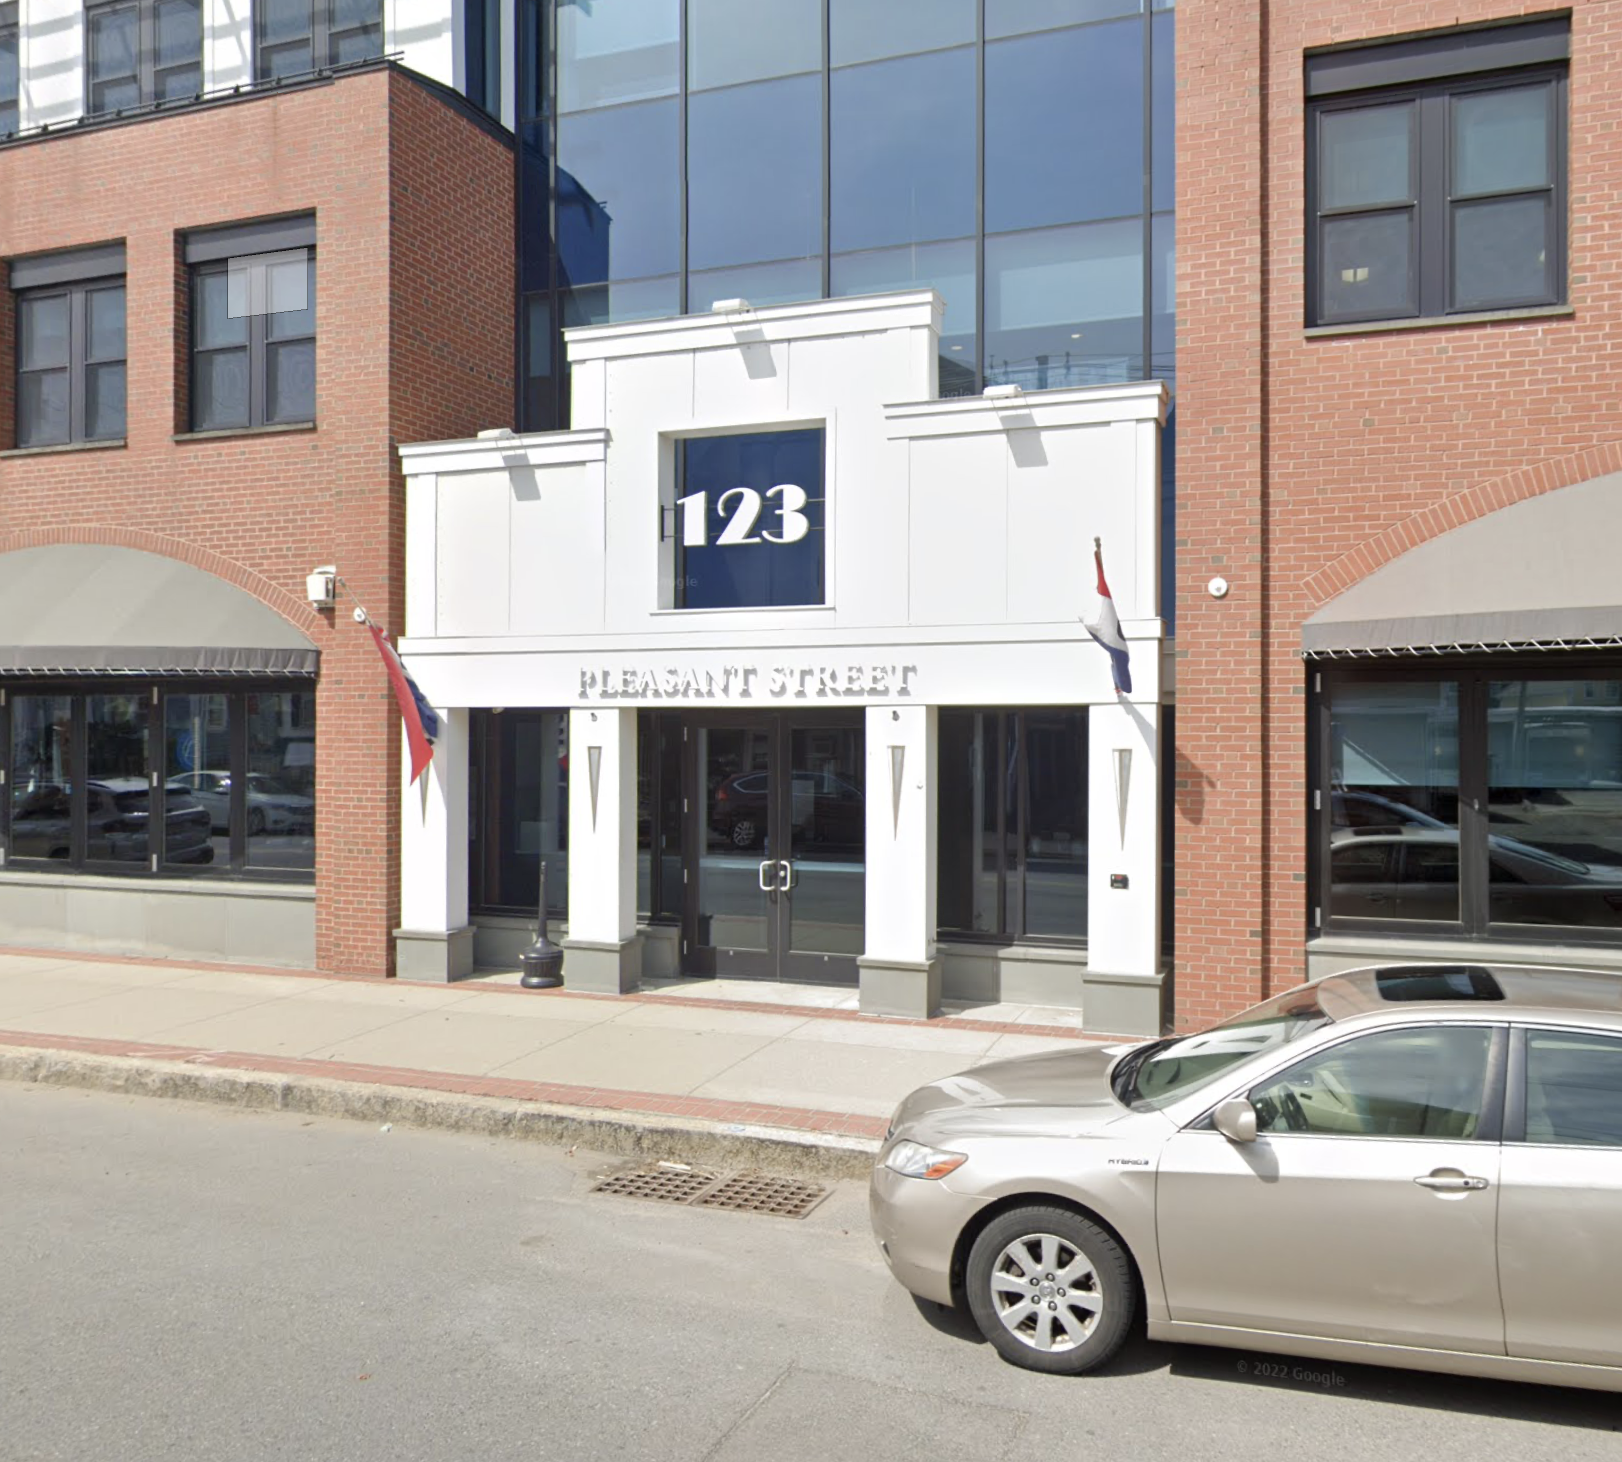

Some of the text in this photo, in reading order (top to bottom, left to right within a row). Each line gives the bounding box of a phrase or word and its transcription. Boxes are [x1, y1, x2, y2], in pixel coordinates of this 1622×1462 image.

[676, 484, 809, 546] 123
[579, 663, 918, 699] PLEASANT STREET
